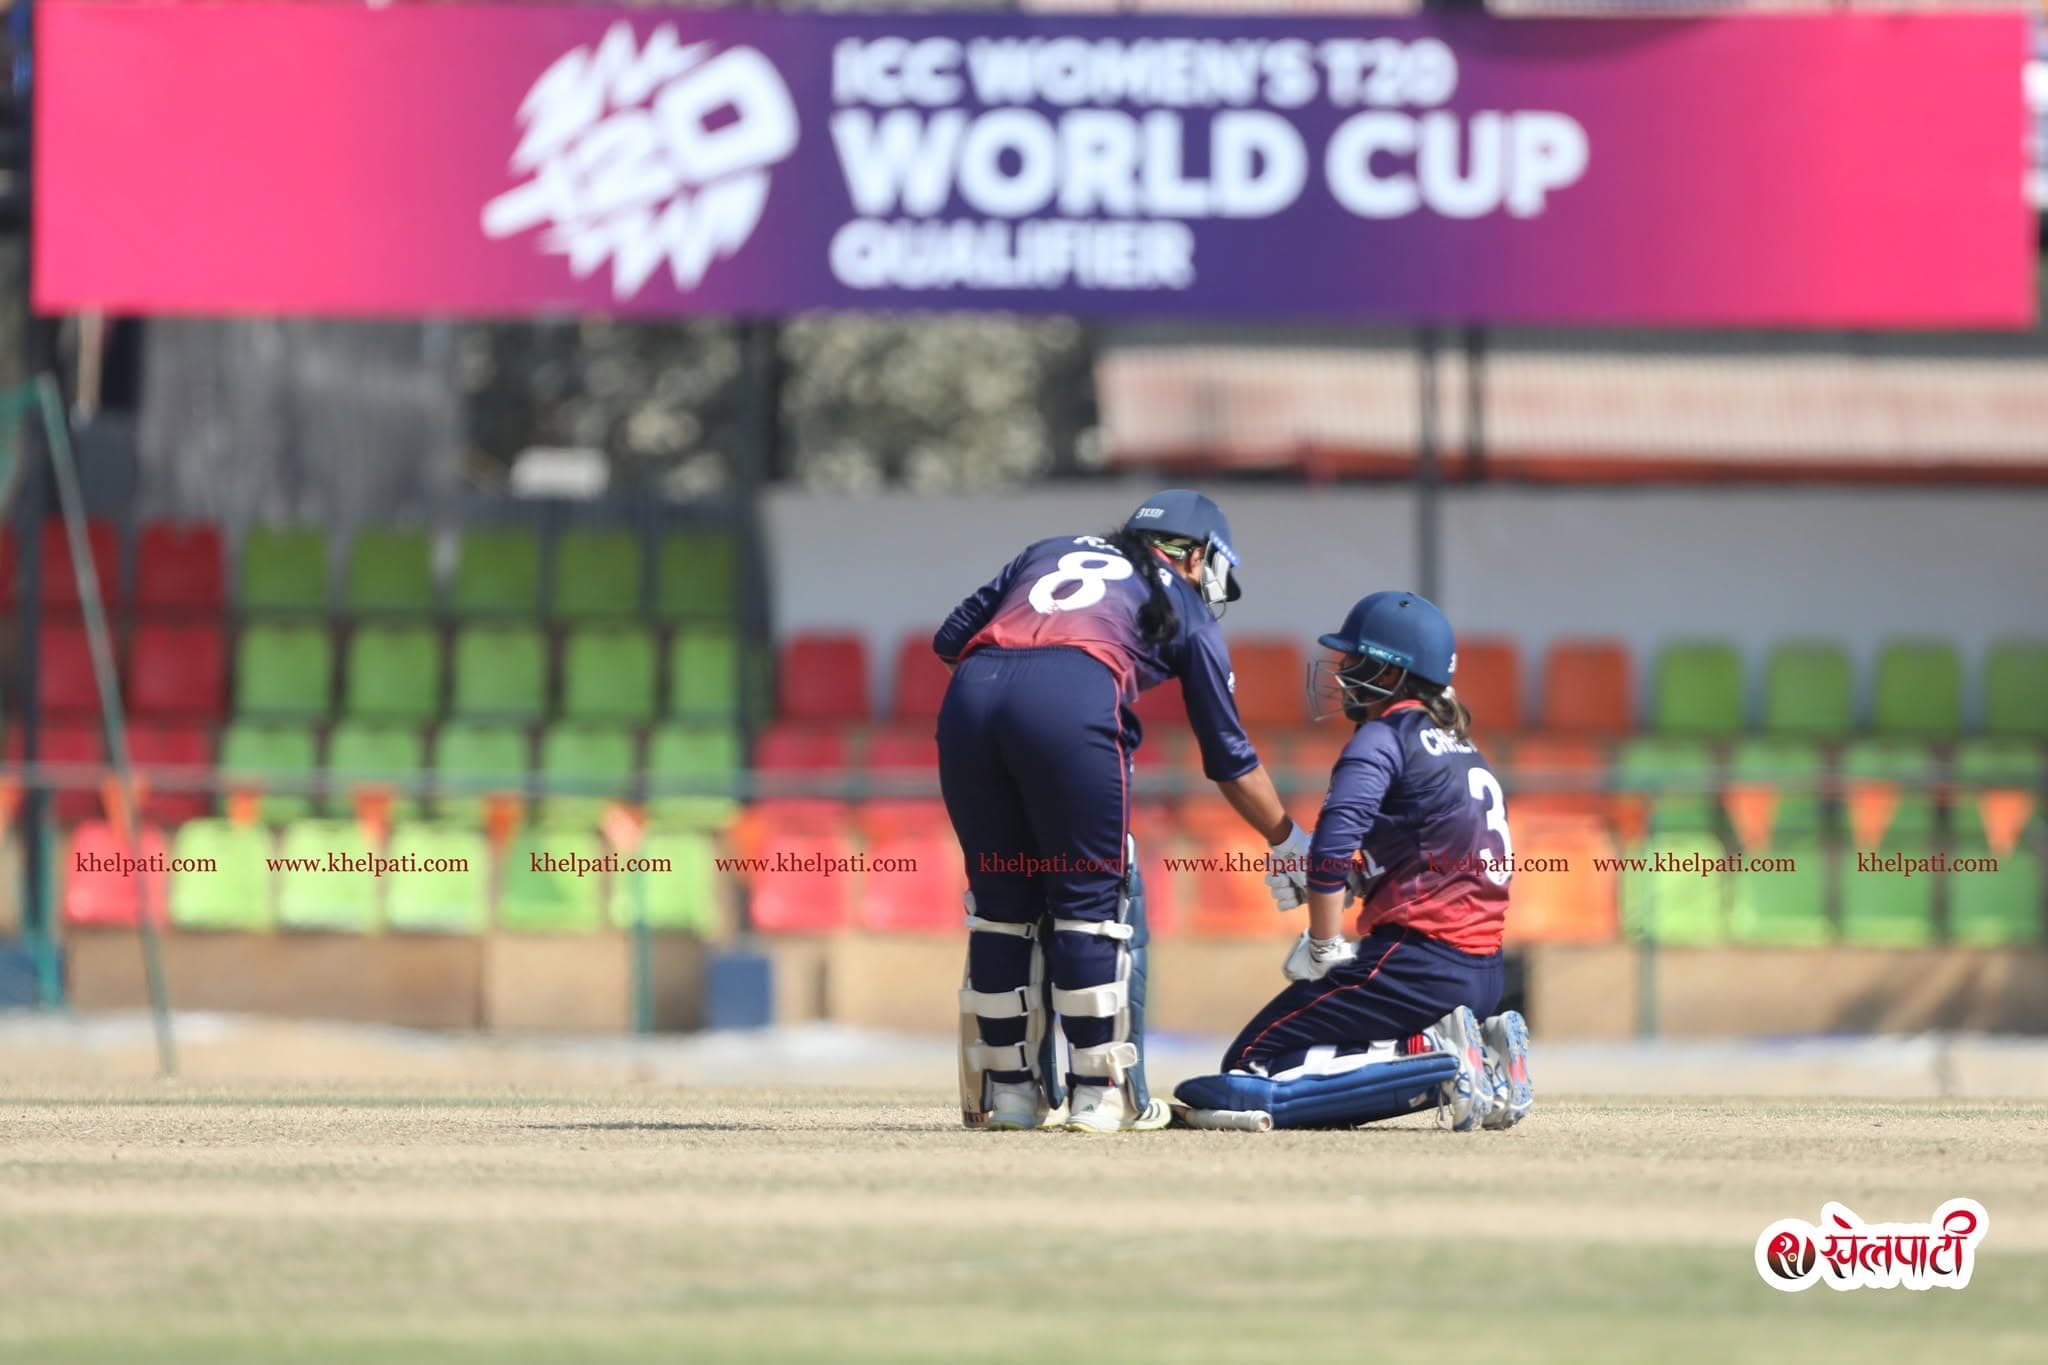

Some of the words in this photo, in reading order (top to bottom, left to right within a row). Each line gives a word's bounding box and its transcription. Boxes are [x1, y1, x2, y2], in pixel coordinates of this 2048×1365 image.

[834, 38, 956, 104] ICC
[970, 38, 1314, 105] WOMEN'S
[1323, 39, 1456, 104] T20
[833, 110, 1304, 218] WORLD
[1328, 110, 1587, 217] CUP
[832, 220, 1192, 288] QUALIFIER
[1028, 551, 1134, 613] 8
[1467, 767, 1513, 886] 3
